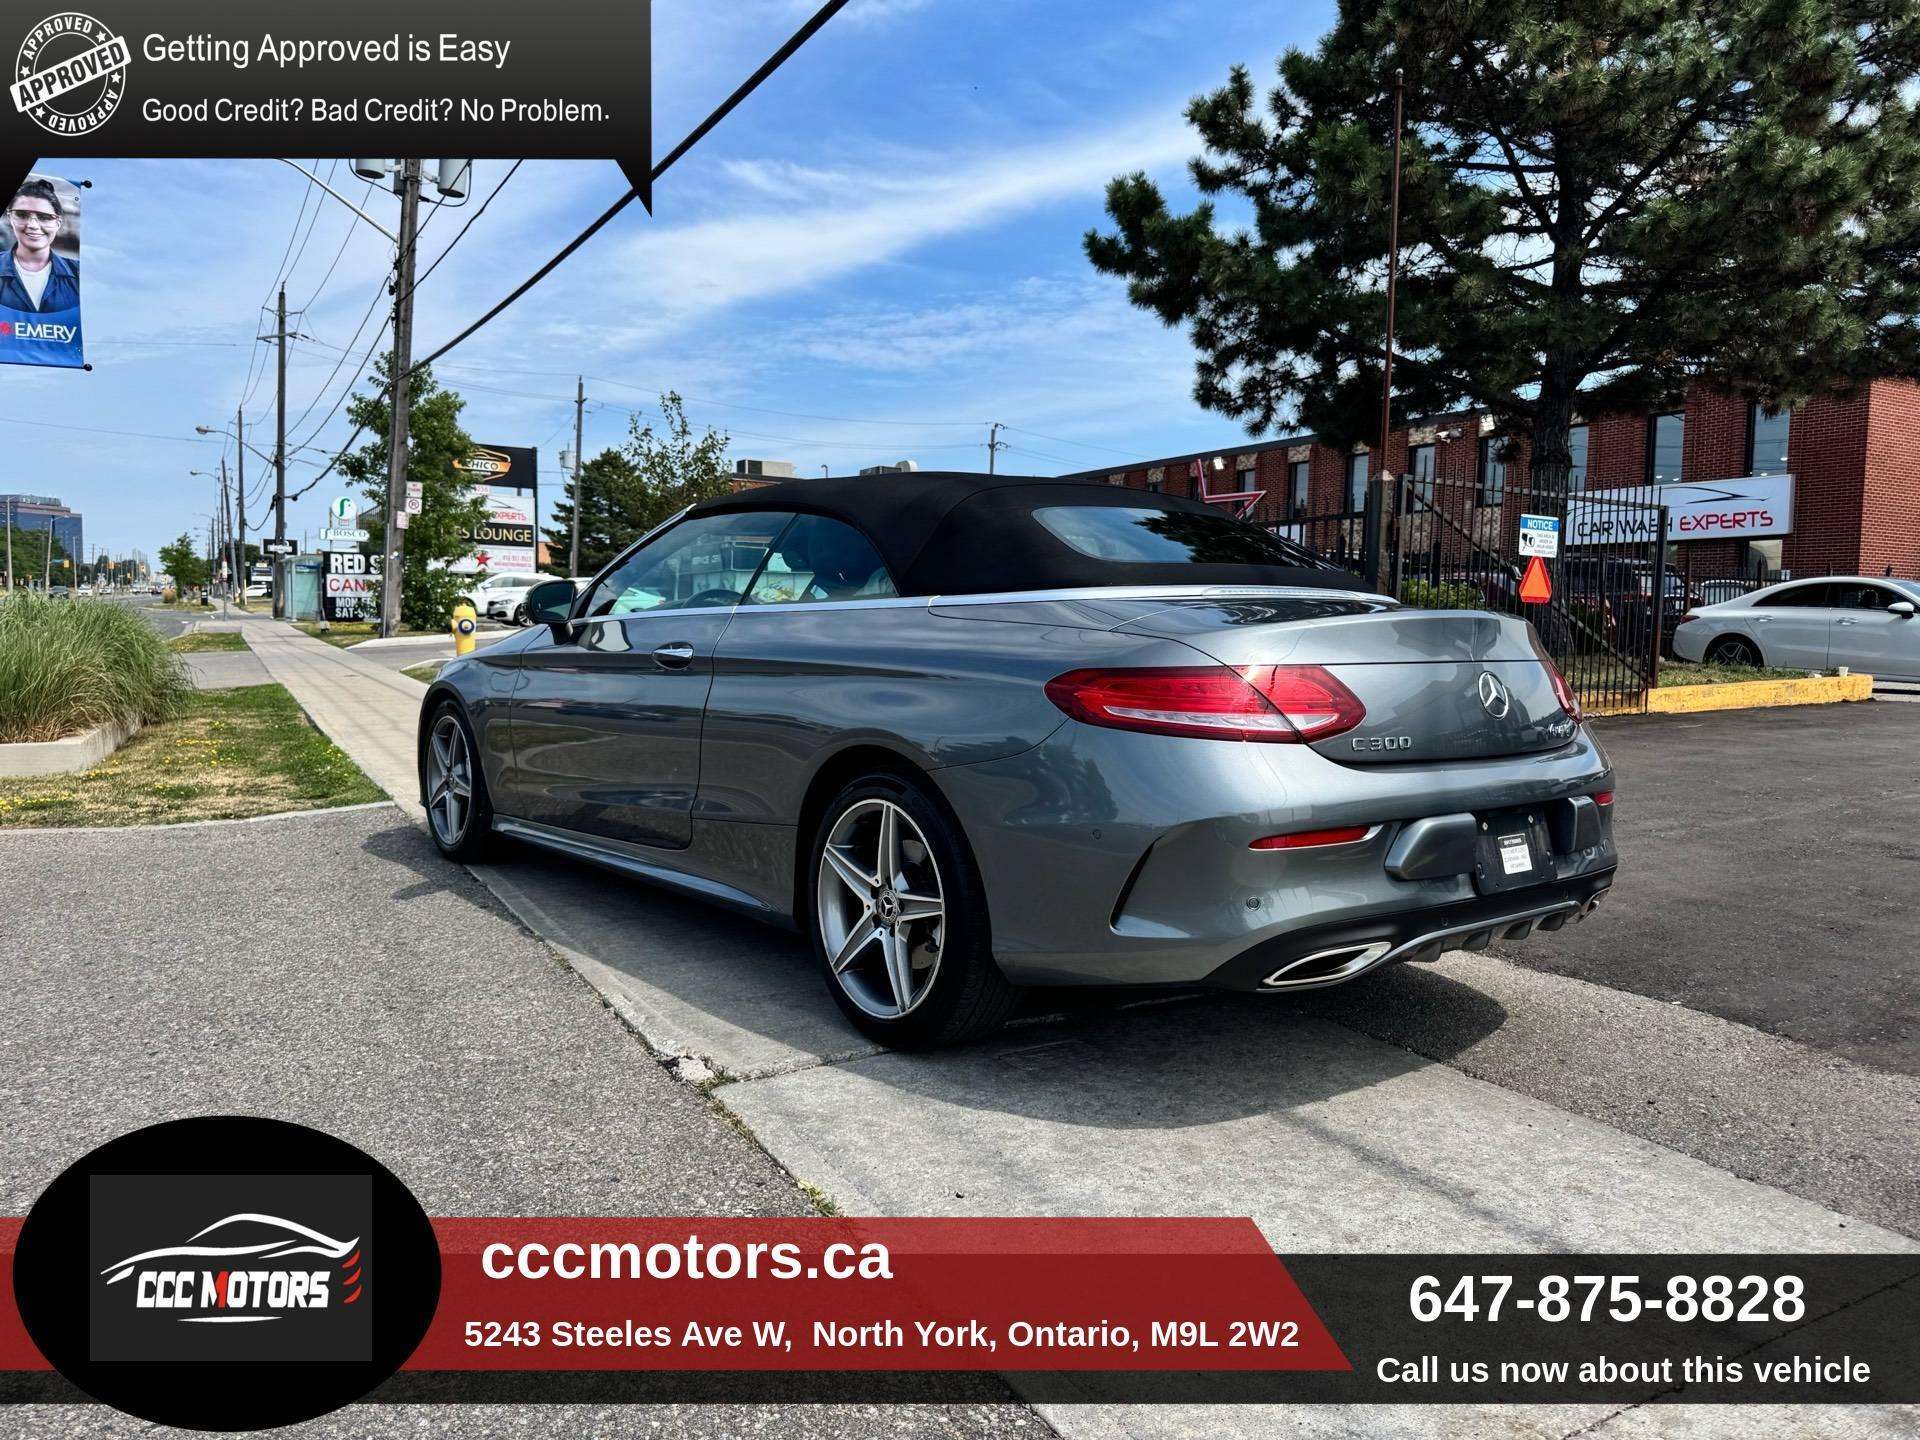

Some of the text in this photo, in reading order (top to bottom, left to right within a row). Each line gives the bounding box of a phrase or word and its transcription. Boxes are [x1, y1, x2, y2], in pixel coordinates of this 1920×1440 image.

[1527, 518, 1554, 531] NOTICE
[1577, 520, 1614, 537] CAR
[1679, 510, 1774, 532] EXPERTS
[474, 525, 532, 542] LOUNGE
[329, 553, 366, 575] RED
